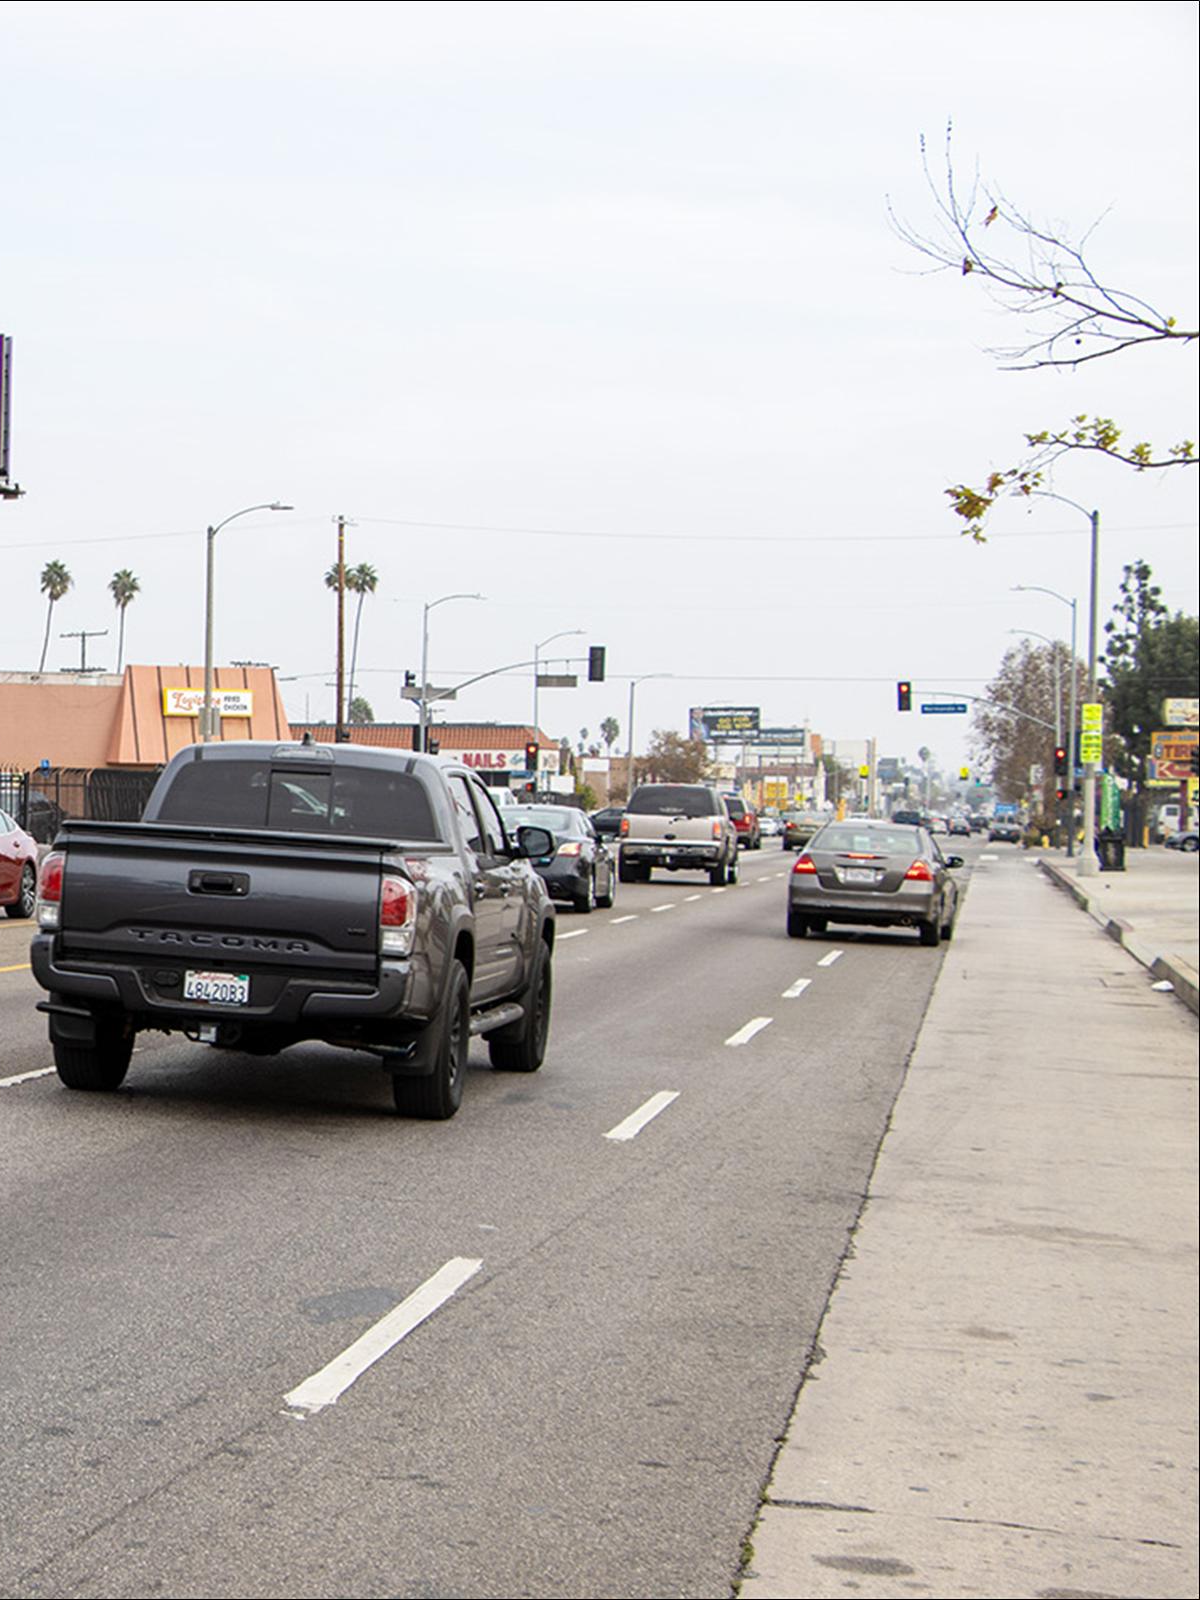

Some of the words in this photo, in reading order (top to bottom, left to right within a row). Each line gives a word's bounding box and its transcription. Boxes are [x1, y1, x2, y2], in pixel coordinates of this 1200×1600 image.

[462, 752, 507, 769] NAILS
[127, 927, 310, 955] TACOMA
[186, 981, 247, 1003] 48420B3
